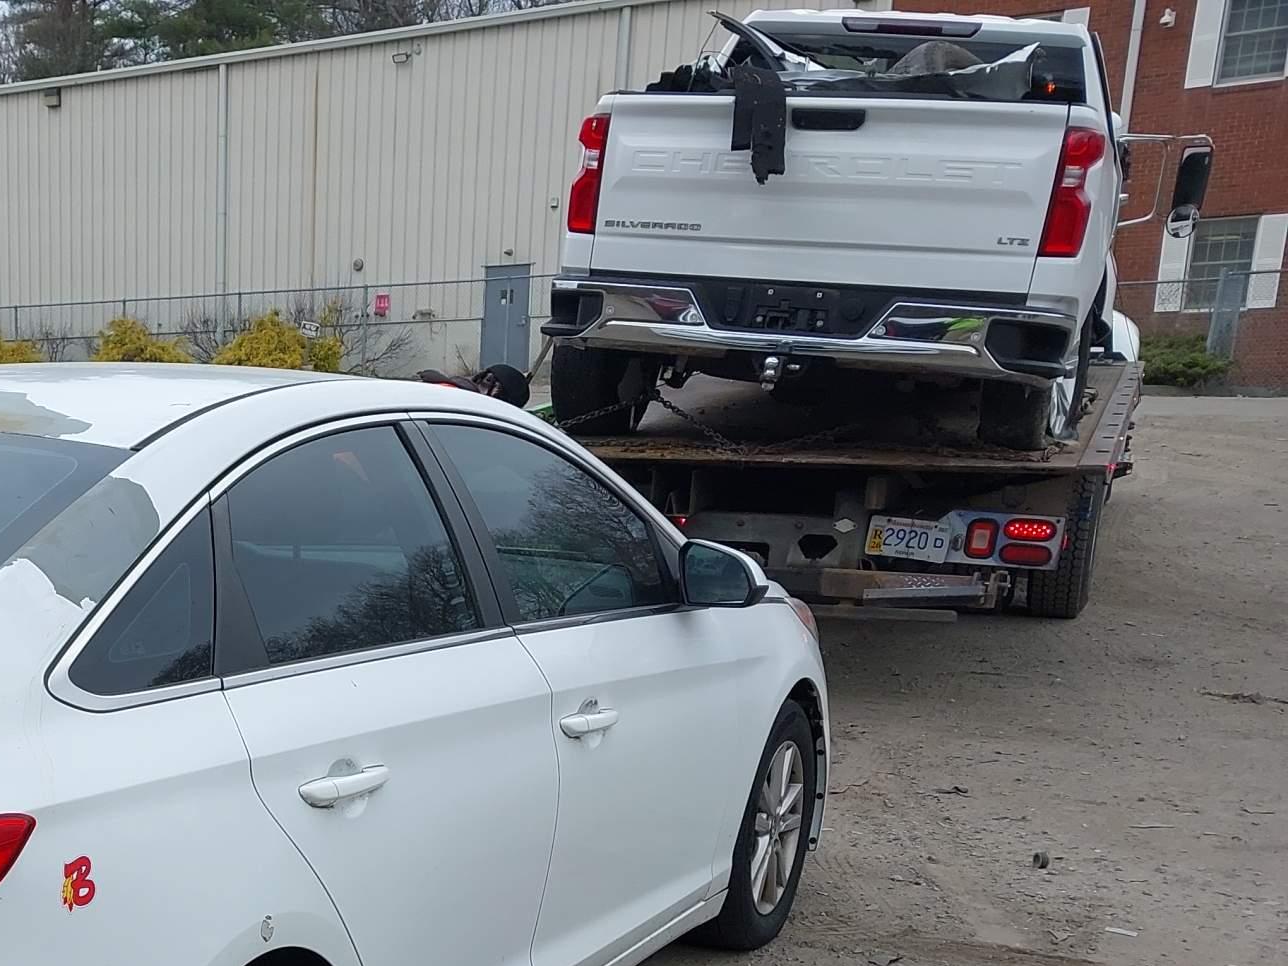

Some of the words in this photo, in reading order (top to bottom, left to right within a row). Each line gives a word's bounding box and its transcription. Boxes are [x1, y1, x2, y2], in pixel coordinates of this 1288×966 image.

[631, 150, 1023, 184] CHEROLET
[604, 219, 702, 231] SILVERADO
[997, 237, 1030, 247] LTZ
[883, 527, 929, 550] 2920
[933, 537, 944, 549] D
